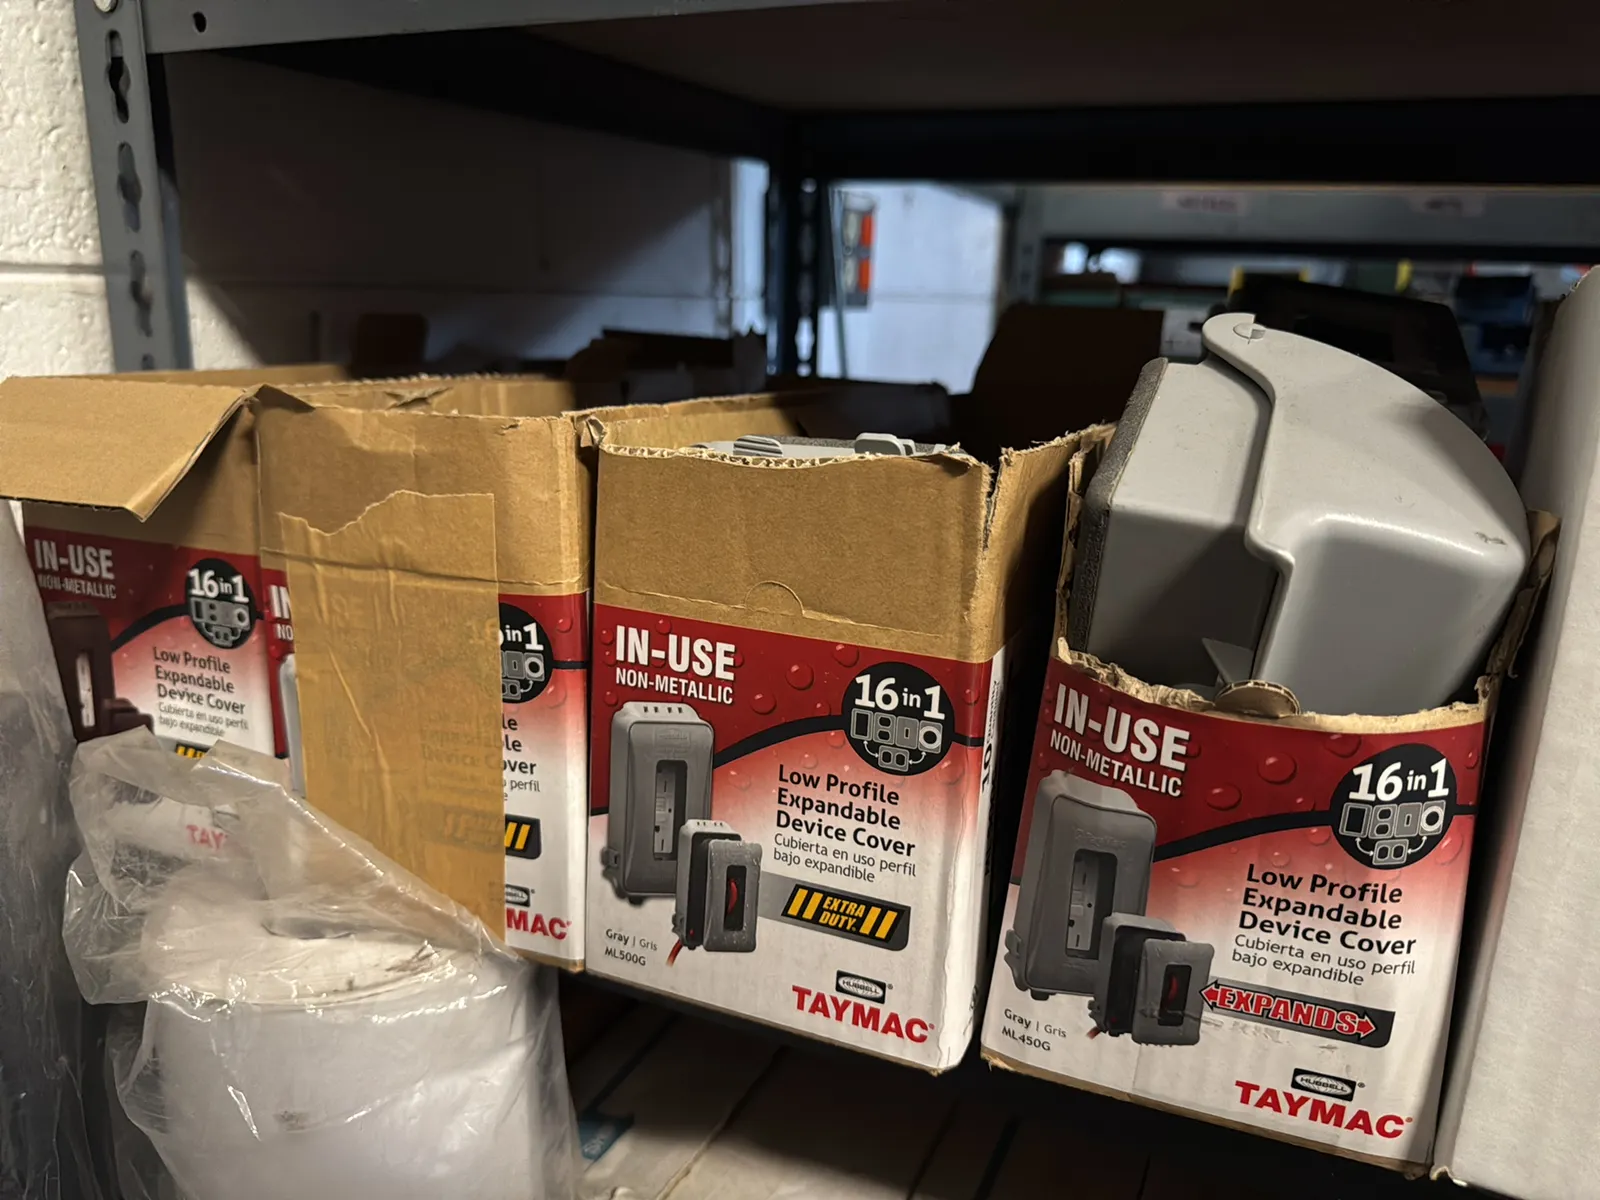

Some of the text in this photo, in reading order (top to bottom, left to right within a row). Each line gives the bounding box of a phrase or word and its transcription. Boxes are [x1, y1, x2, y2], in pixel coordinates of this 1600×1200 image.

[34, 538, 115, 580] IN-USE
[187, 569, 218, 599] 16
[219, 578, 233, 594] in
[233, 575, 249, 603] 1
[505, 625, 522, 642] in
[523, 622, 544, 651] 1
[616, 625, 736, 681] IN-USE
[153, 647, 231, 674] Low Profile
[155, 665, 235, 693] Expandable
[157, 683, 246, 715] Device Cover
[616, 667, 733, 705] NON-METALLIC
[855, 674, 945, 720] 16 in 1
[1054, 683, 1190, 772] IN-USE
[1050, 729, 1182, 797] NON-METALLIC
[1349, 758, 1449, 801] 16 in 1
[510, 777, 540, 793] perfil
[778, 764, 899, 805] Low Profile
[778, 787, 901, 829] Expandable
[776, 810, 916, 857] Device Cover
[773, 849, 875, 882] bajo expandible
[774, 833, 916, 877] Cubierta en uso perfil
[1247, 863, 1403, 904] Low Profile
[822, 896, 865, 918] EXTRA
[1242, 887, 1402, 929] Expandable
[606, 928, 658, 951] Gray Gris
[1238, 910, 1417, 955] Device Cover
[605, 946, 646, 966] ML500G
[1232, 949, 1364, 986] bajo expandible
[1235, 934, 1415, 976] Cubierta en uso perfil
[843, 979, 880, 994] HUBBELL
[1004, 1008, 1067, 1038] Gray Gris
[1216, 988, 1358, 1035] EXPANDS
[1002, 1026, 1051, 1051] ML450G
[1300, 1076, 1348, 1092] HUBBELL
